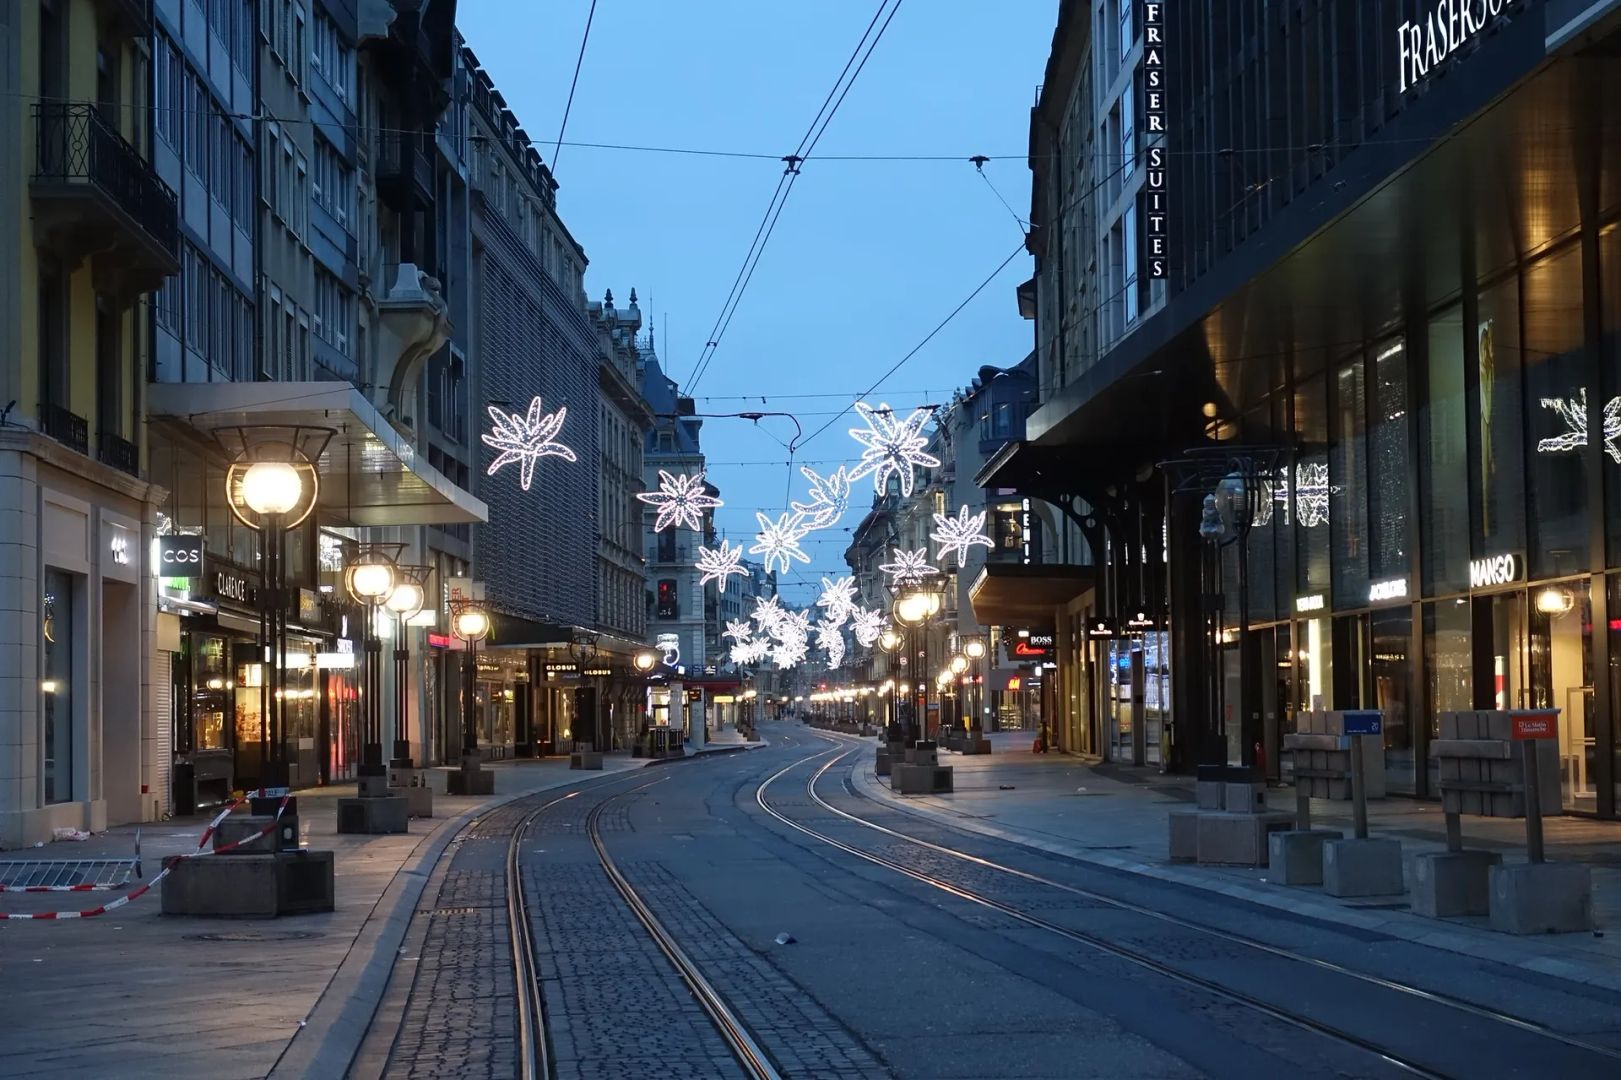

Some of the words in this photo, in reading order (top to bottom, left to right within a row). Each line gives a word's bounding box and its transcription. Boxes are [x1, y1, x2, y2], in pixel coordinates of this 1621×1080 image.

[1146, 4, 1164, 131] FRASER
[1149, 148, 1165, 277] SUITES
[163, 549, 199, 563] COS
[1470, 554, 1514, 587] MANGO
[218, 571, 245, 601] CLARENCE
[1030, 635, 1052, 643] BOSS
